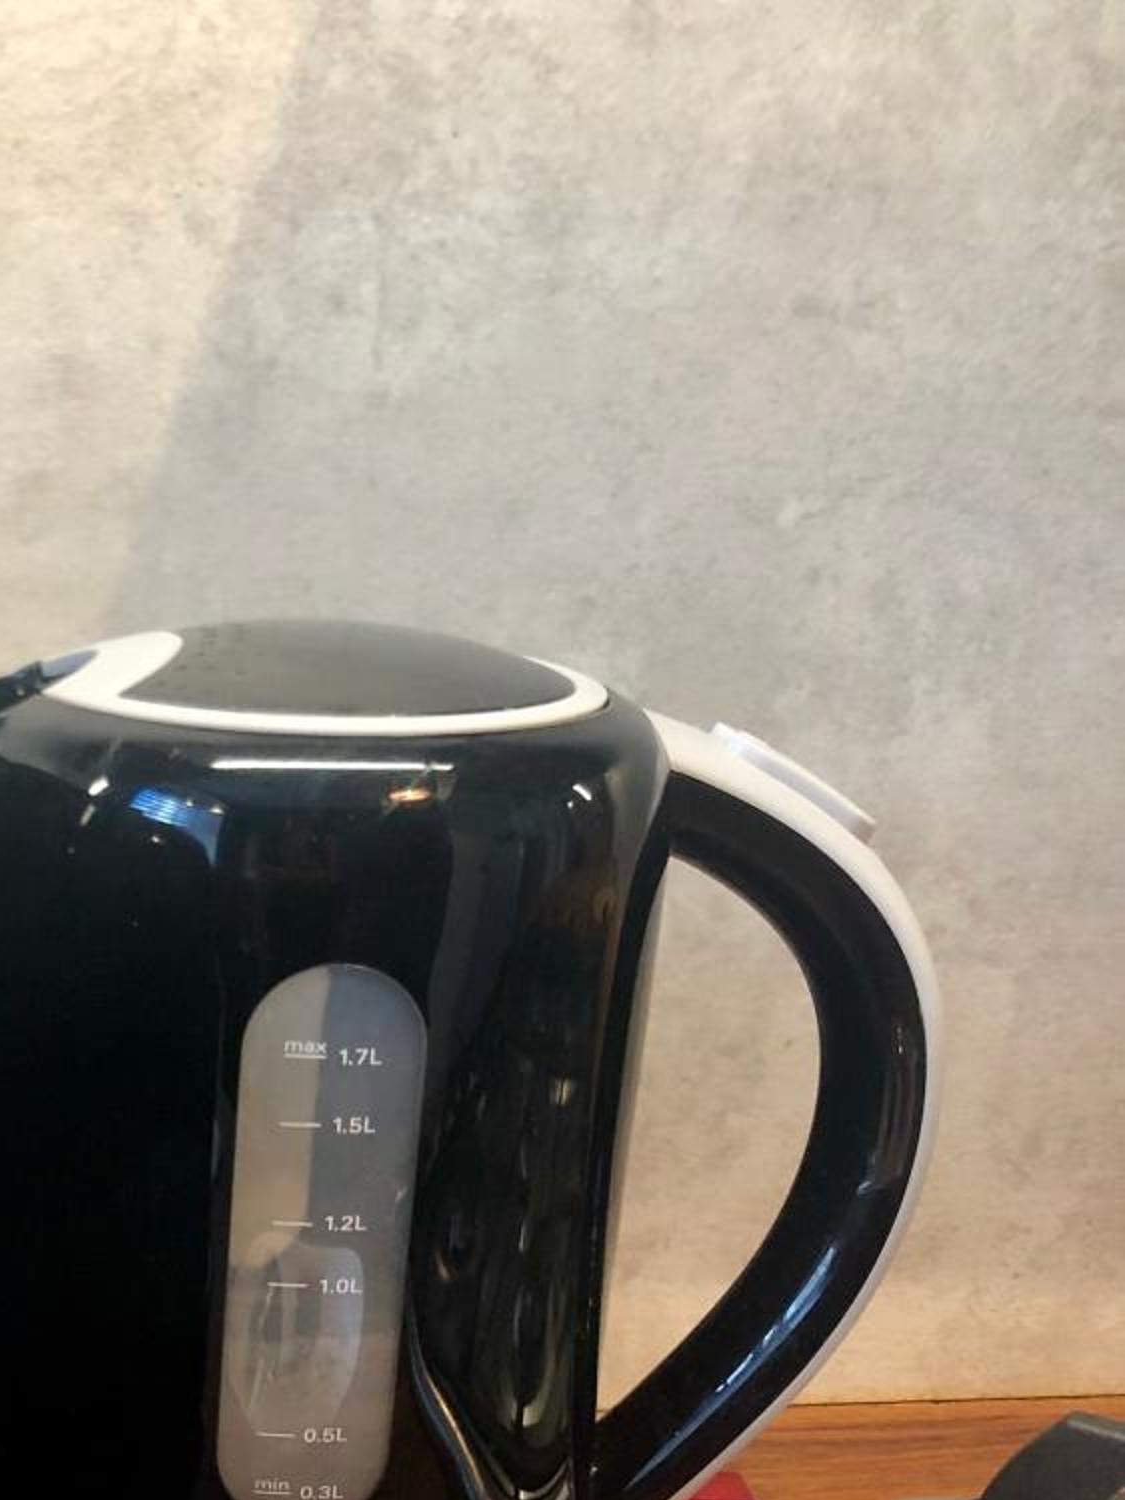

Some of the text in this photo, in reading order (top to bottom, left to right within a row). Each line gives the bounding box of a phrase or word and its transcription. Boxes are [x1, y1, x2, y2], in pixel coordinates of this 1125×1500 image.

[283, 1040, 383, 1066] max 1.7L
[332, 1116, 376, 1134] 1.5L
[325, 1215, 367, 1232] 1.2L
[319, 1278, 363, 1294] 1.0L
[303, 1428, 348, 1443] 0.5L
[253, 1477, 344, 1500] min 0.3L
